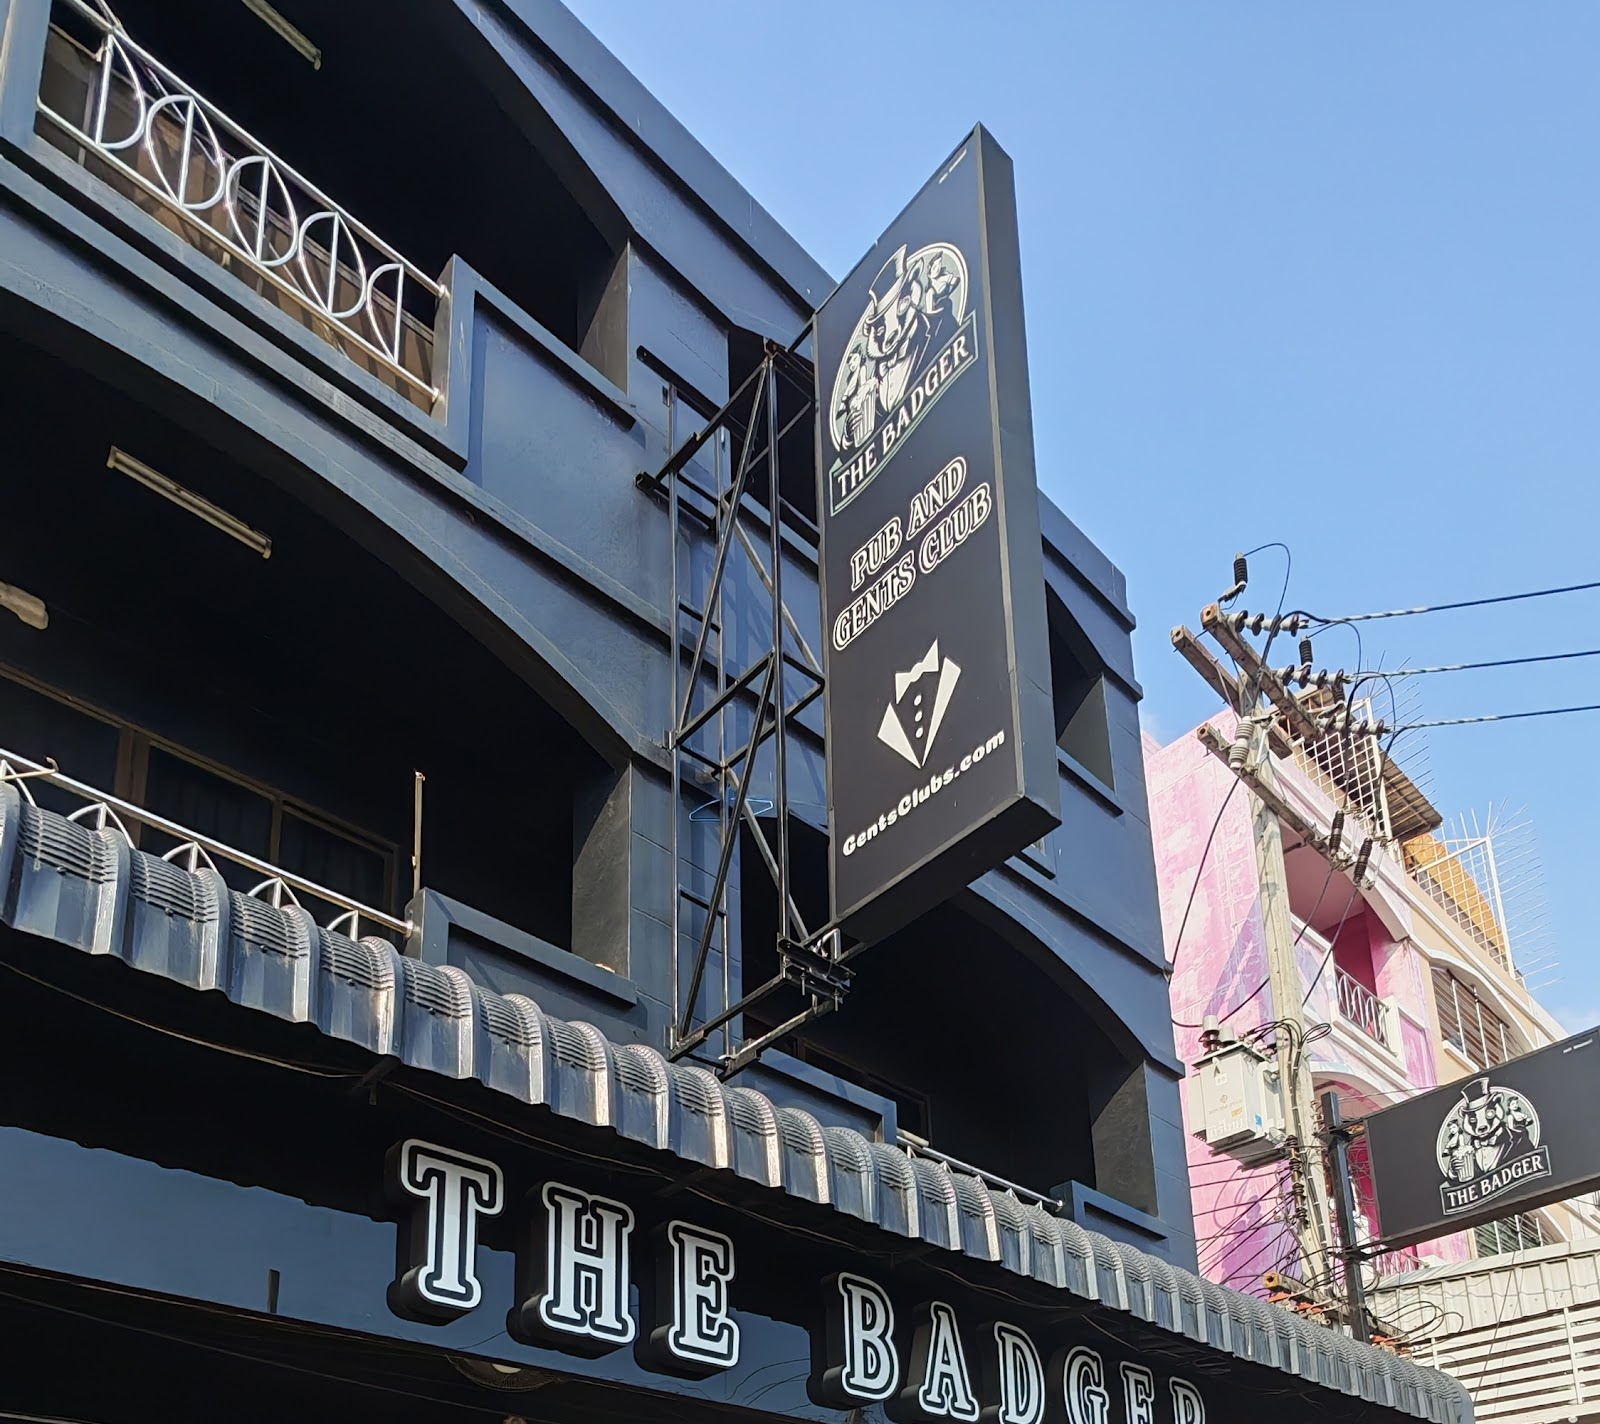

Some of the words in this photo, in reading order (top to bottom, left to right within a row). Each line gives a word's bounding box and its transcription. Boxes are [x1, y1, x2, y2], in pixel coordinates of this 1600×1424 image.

[838, 442, 878, 498] THE
[882, 335, 969, 456] BADGER
[833, 550, 916, 651] GENTS
[919, 482, 992, 574] CLUB
[851, 516, 902, 592] PUB
[906, 456, 967, 541] AND
[842, 729, 1005, 857] GentsClubs.com
[400, 1138, 741, 1368] THE
[1446, 1185, 1479, 1207] THE
[1480, 1155, 1545, 1197] BADGER
